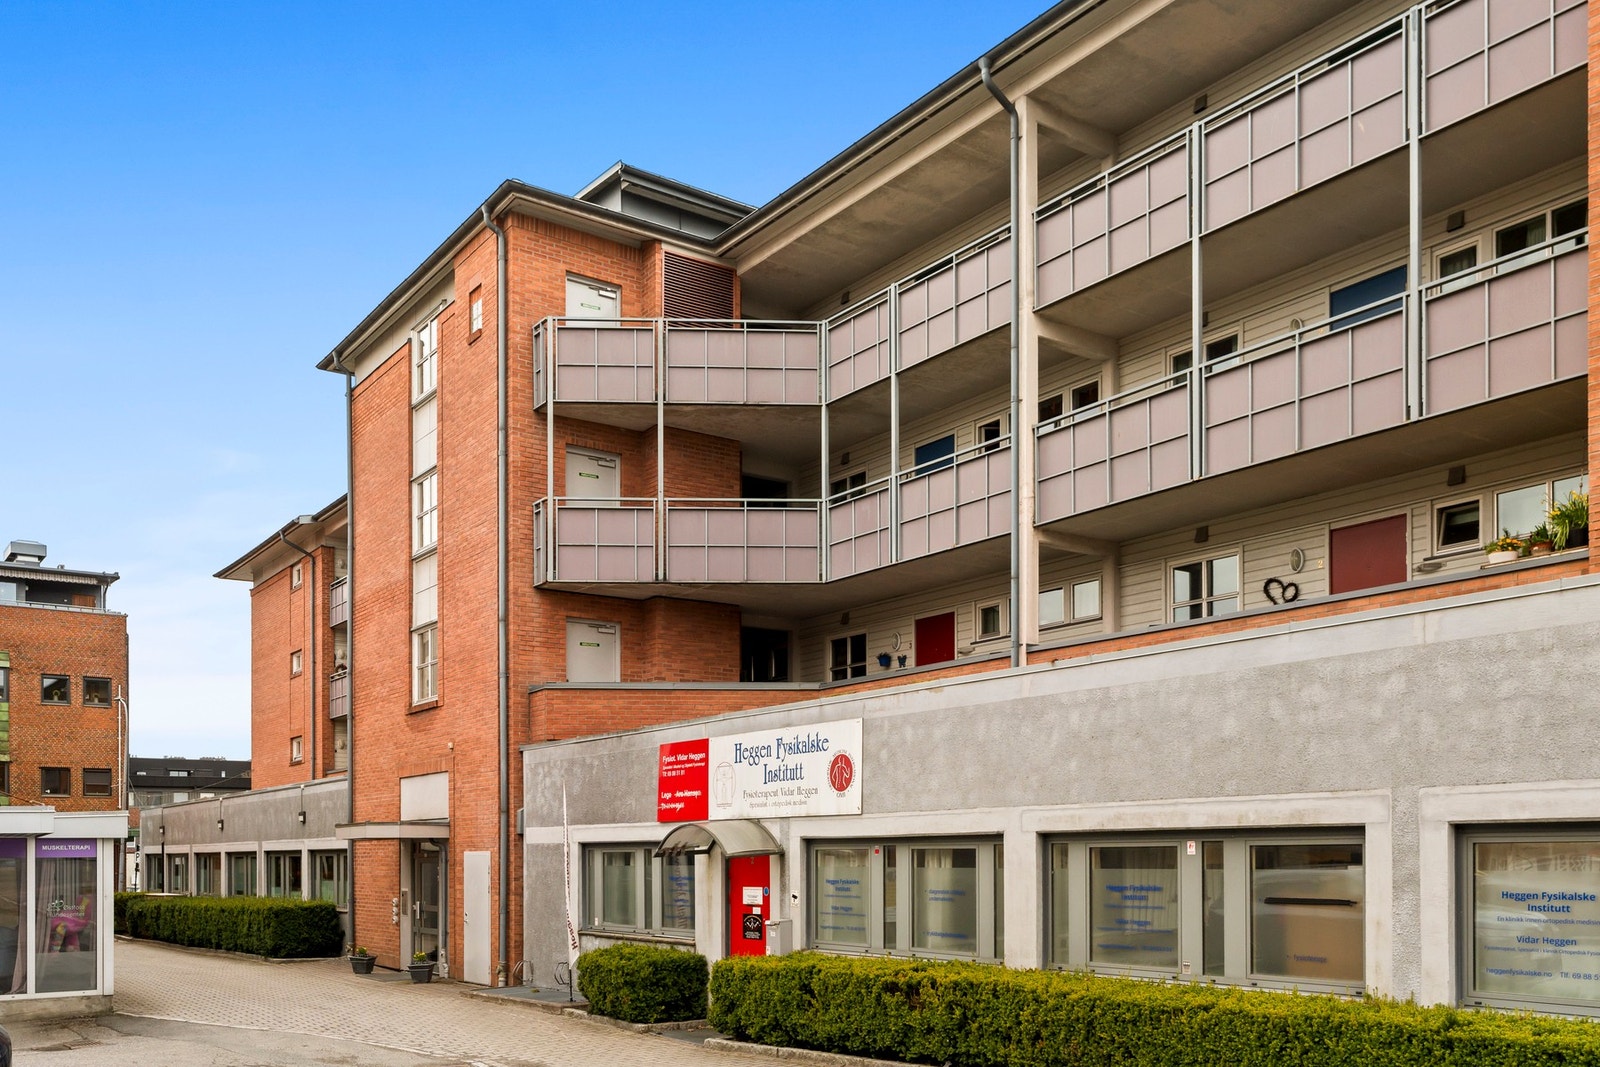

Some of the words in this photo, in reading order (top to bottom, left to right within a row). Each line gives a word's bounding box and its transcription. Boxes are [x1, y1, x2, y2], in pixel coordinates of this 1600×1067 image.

[1317, 559, 1324, 569] 2
[734, 742, 772, 767] Heggen
[776, 731, 830, 762] Fysikalske
[677, 753, 688, 762] Vidar
[688, 752, 706, 761] Heggen
[763, 761, 805, 785] Institutt
[742, 788, 779, 802] Fysioterapeut
[780, 787, 795, 797] Vidar
[796, 785, 819, 799] Heggen
[1501, 890, 1539, 902] Heggen
[1541, 891, 1596, 903] Fysikalske
[1527, 903, 1571, 913] Institutt
[1505, 915, 1524, 923] klinikk
[1542, 917, 1575, 926] ortopedisk
[1516, 935, 1540, 944] Vidar
[1542, 936, 1577, 948] Heggen
[1485, 967, 1553, 979] heggenfysikalske.no
[1572, 972, 1582, 980] 69
[1583, 973, 1593, 981] 88
